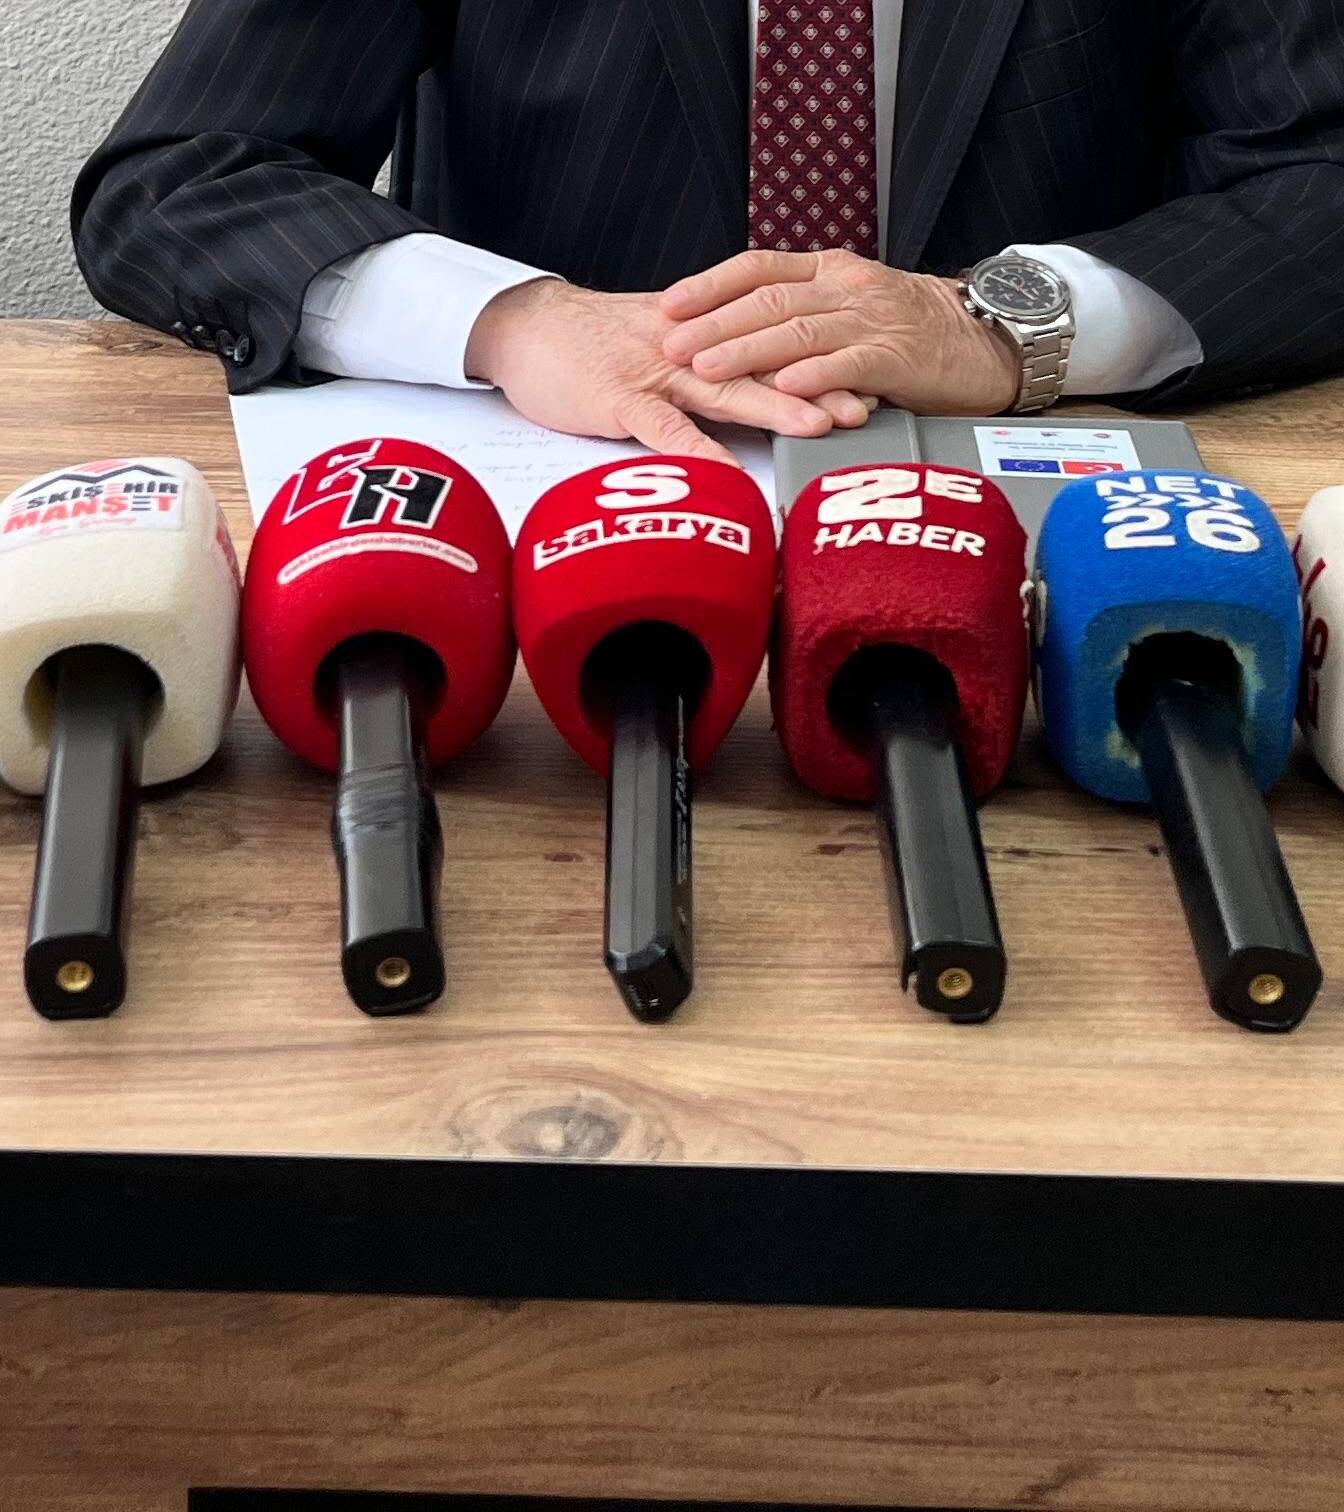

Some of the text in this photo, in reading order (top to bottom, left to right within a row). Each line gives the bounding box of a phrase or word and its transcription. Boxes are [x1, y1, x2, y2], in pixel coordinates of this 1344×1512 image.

[594, 463, 691, 510] S
[1094, 475, 1245, 499] NET
[813, 521, 987, 557] HABER
[1101, 506, 1261, 554] 26
